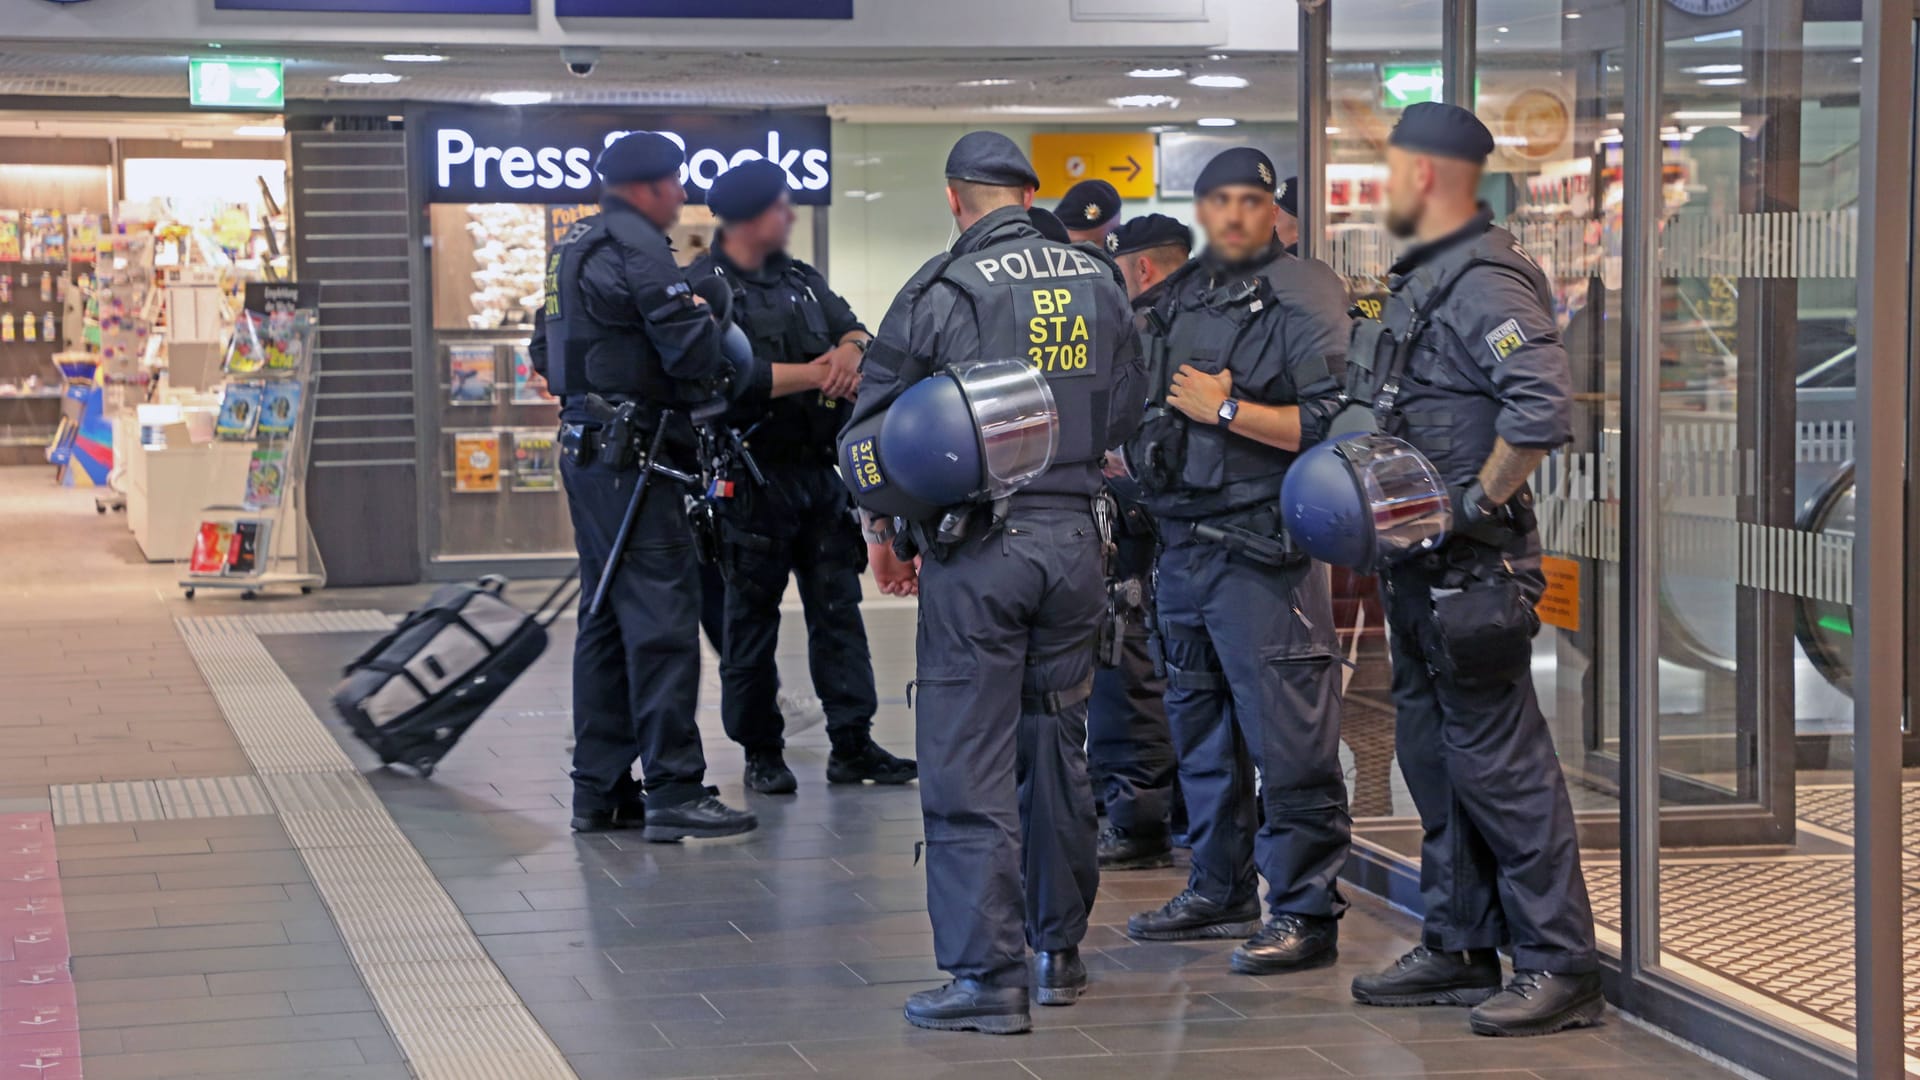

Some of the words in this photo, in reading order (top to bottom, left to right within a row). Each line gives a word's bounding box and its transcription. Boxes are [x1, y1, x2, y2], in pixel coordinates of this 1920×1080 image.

[437, 128, 592, 190] Press
[975, 247, 1102, 282] POLIZEI
[1032, 288, 1072, 315] BP
[1357, 299, 1382, 319] BP
[1029, 315, 1089, 344] STA
[1028, 344, 1088, 372] 3708
[860, 440, 882, 485] 3708
